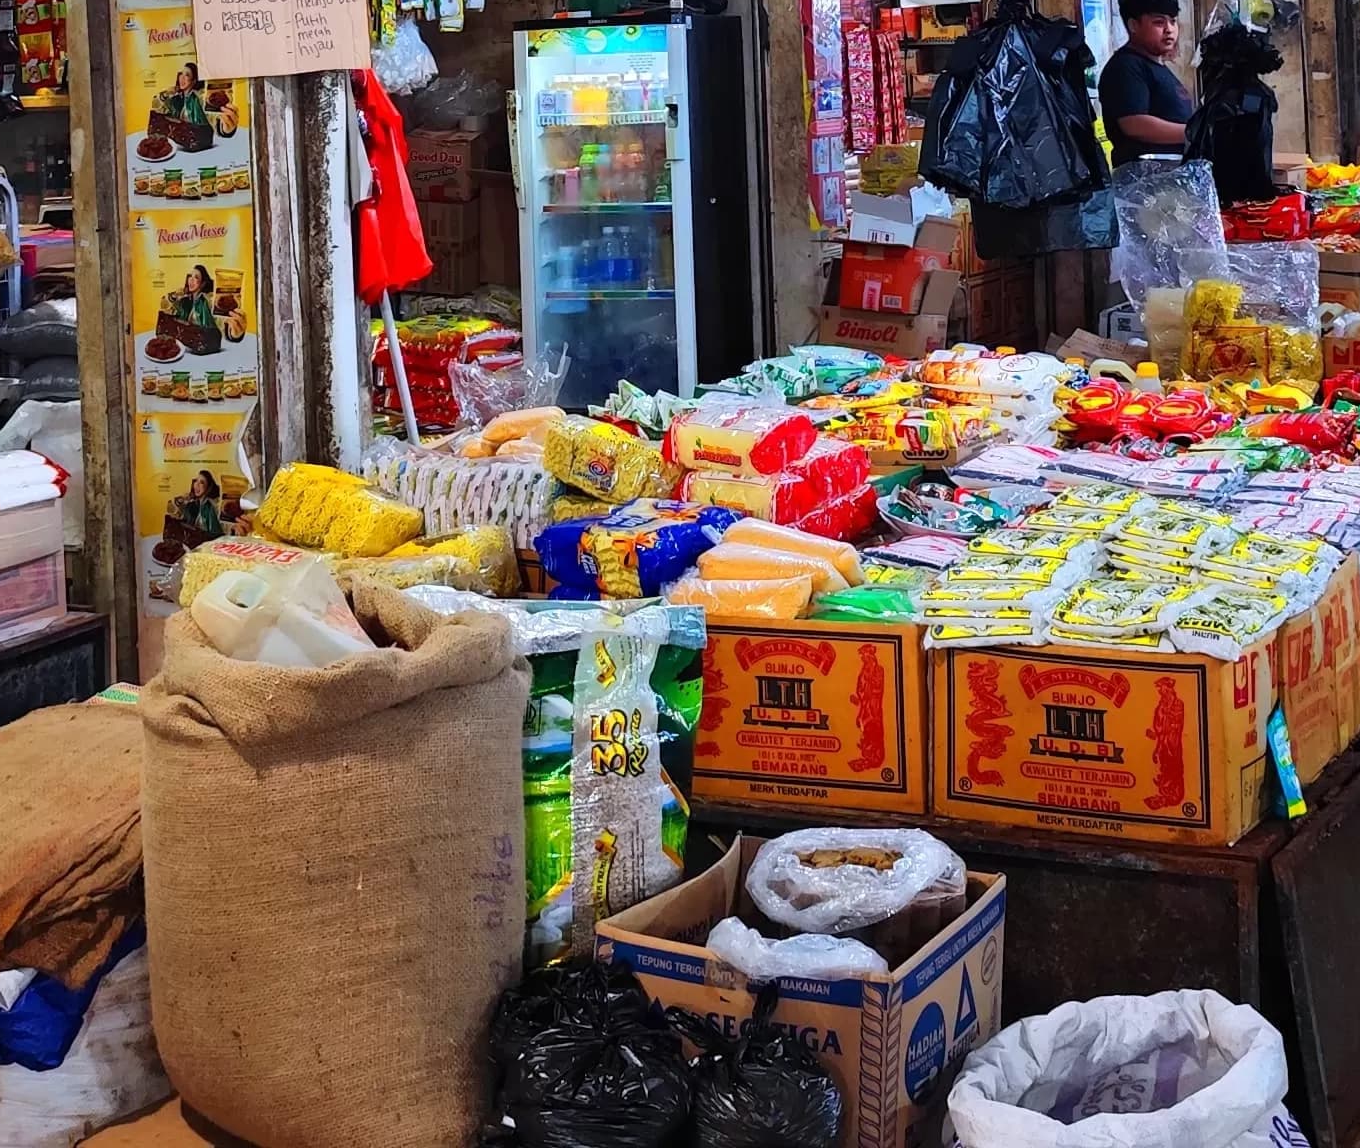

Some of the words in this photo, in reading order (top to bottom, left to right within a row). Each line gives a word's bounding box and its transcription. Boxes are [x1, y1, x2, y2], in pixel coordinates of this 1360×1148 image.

[410, 151, 437, 163] Good
[440, 152, 462, 165] Day
[836, 319, 899, 343] Bimoli
[752, 642, 816, 661] EMPING
[765, 663, 805, 675] BLINJO
[1040, 671, 1109, 694] EMPING
[1052, 692, 1096, 706] BLINJO
[590, 708, 628, 777] 35
[741, 733, 784, 746] KWALITET
[790, 736, 836, 749] TERJAMIN
[752, 760, 828, 776] SEMARANG
[1026, 763, 1073, 778] KWALITET
[1079, 768, 1131, 785] TERJAMIN
[749, 783, 775, 794] MERK
[775, 785, 829, 798] TERDAFTAR
[1037, 792, 1121, 812] SEMARANG
[1037, 813, 1064, 826] MERK
[1066, 816, 1123, 832] TERDAFTAR
[637, 954, 673, 971] TEPUNG
[674, 962, 708, 979] TERIGU
[709, 966, 736, 983] UNTU
[780, 979, 831, 996] MAKANAN
[908, 1023, 944, 1062] HADIAH
